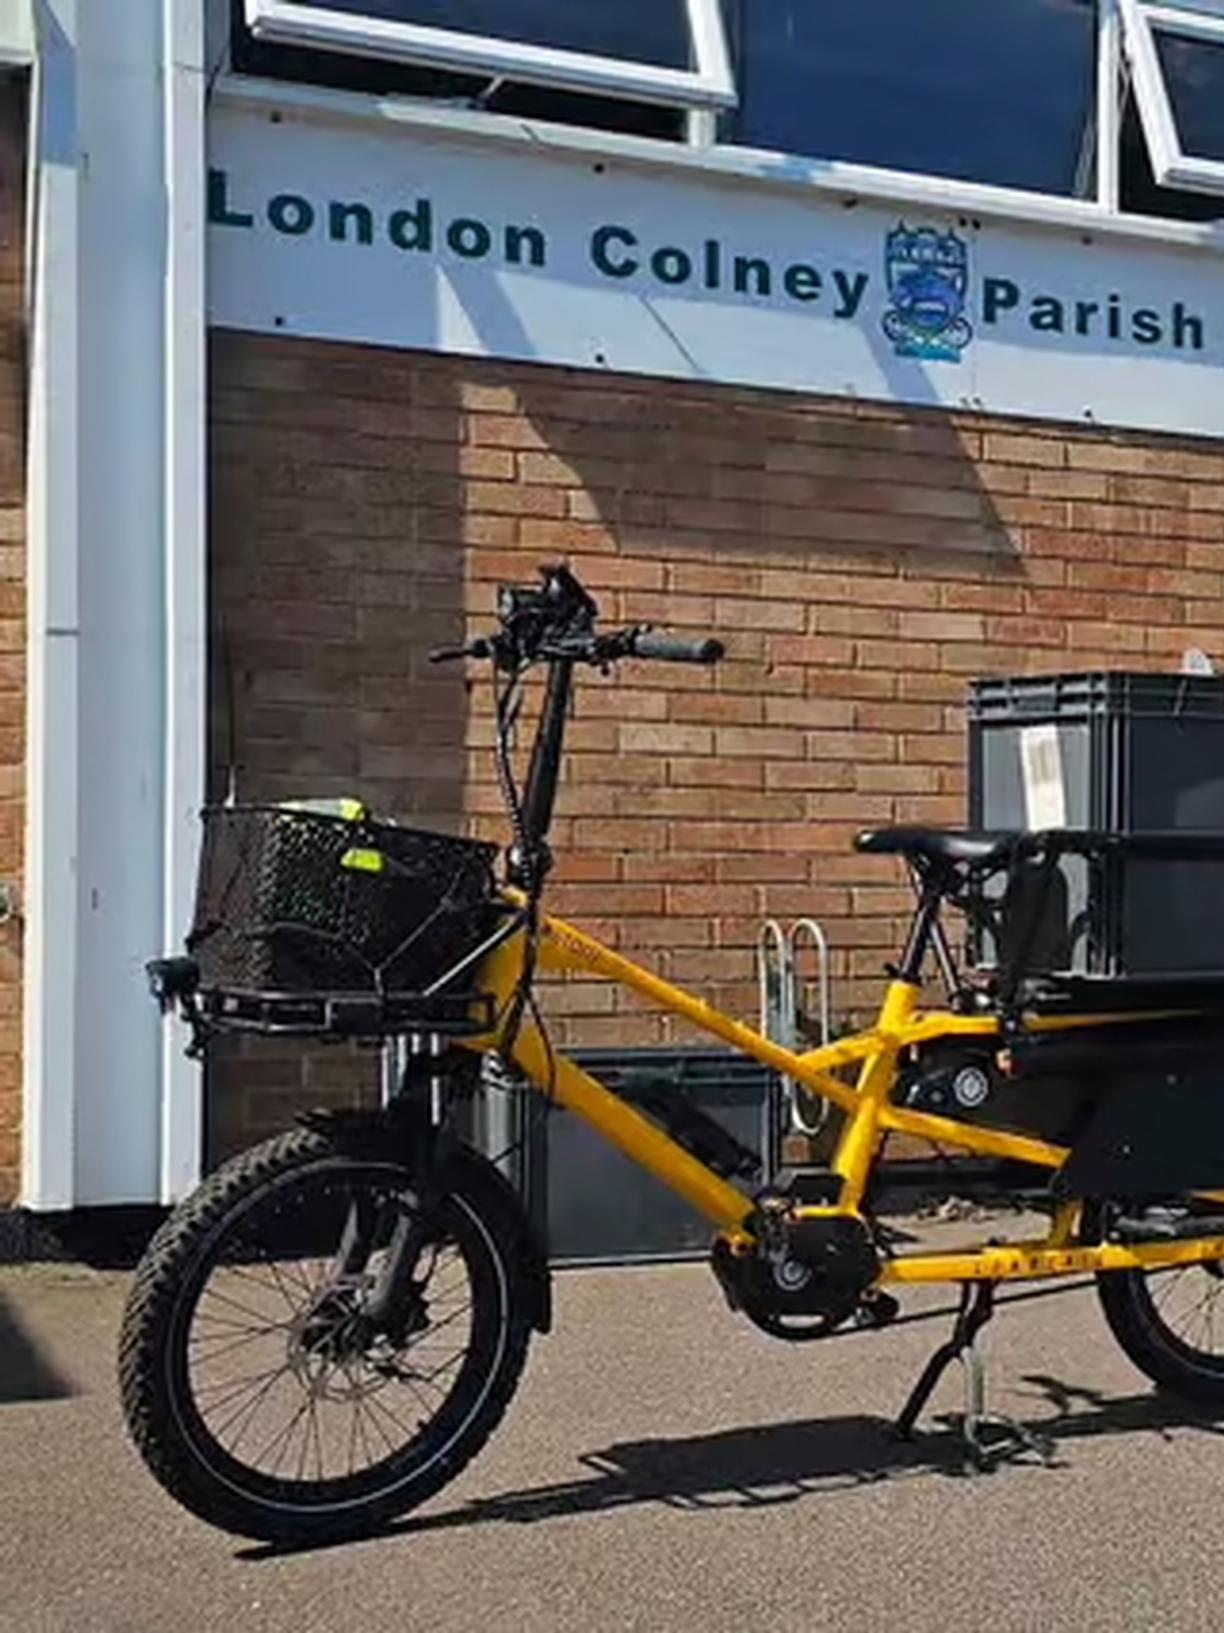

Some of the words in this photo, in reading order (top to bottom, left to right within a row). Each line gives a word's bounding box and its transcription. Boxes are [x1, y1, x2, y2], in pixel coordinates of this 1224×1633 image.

[207, 167, 546, 267] London
[589, 225, 869, 318] Colney
[982, 276, 1204, 349] Parish
